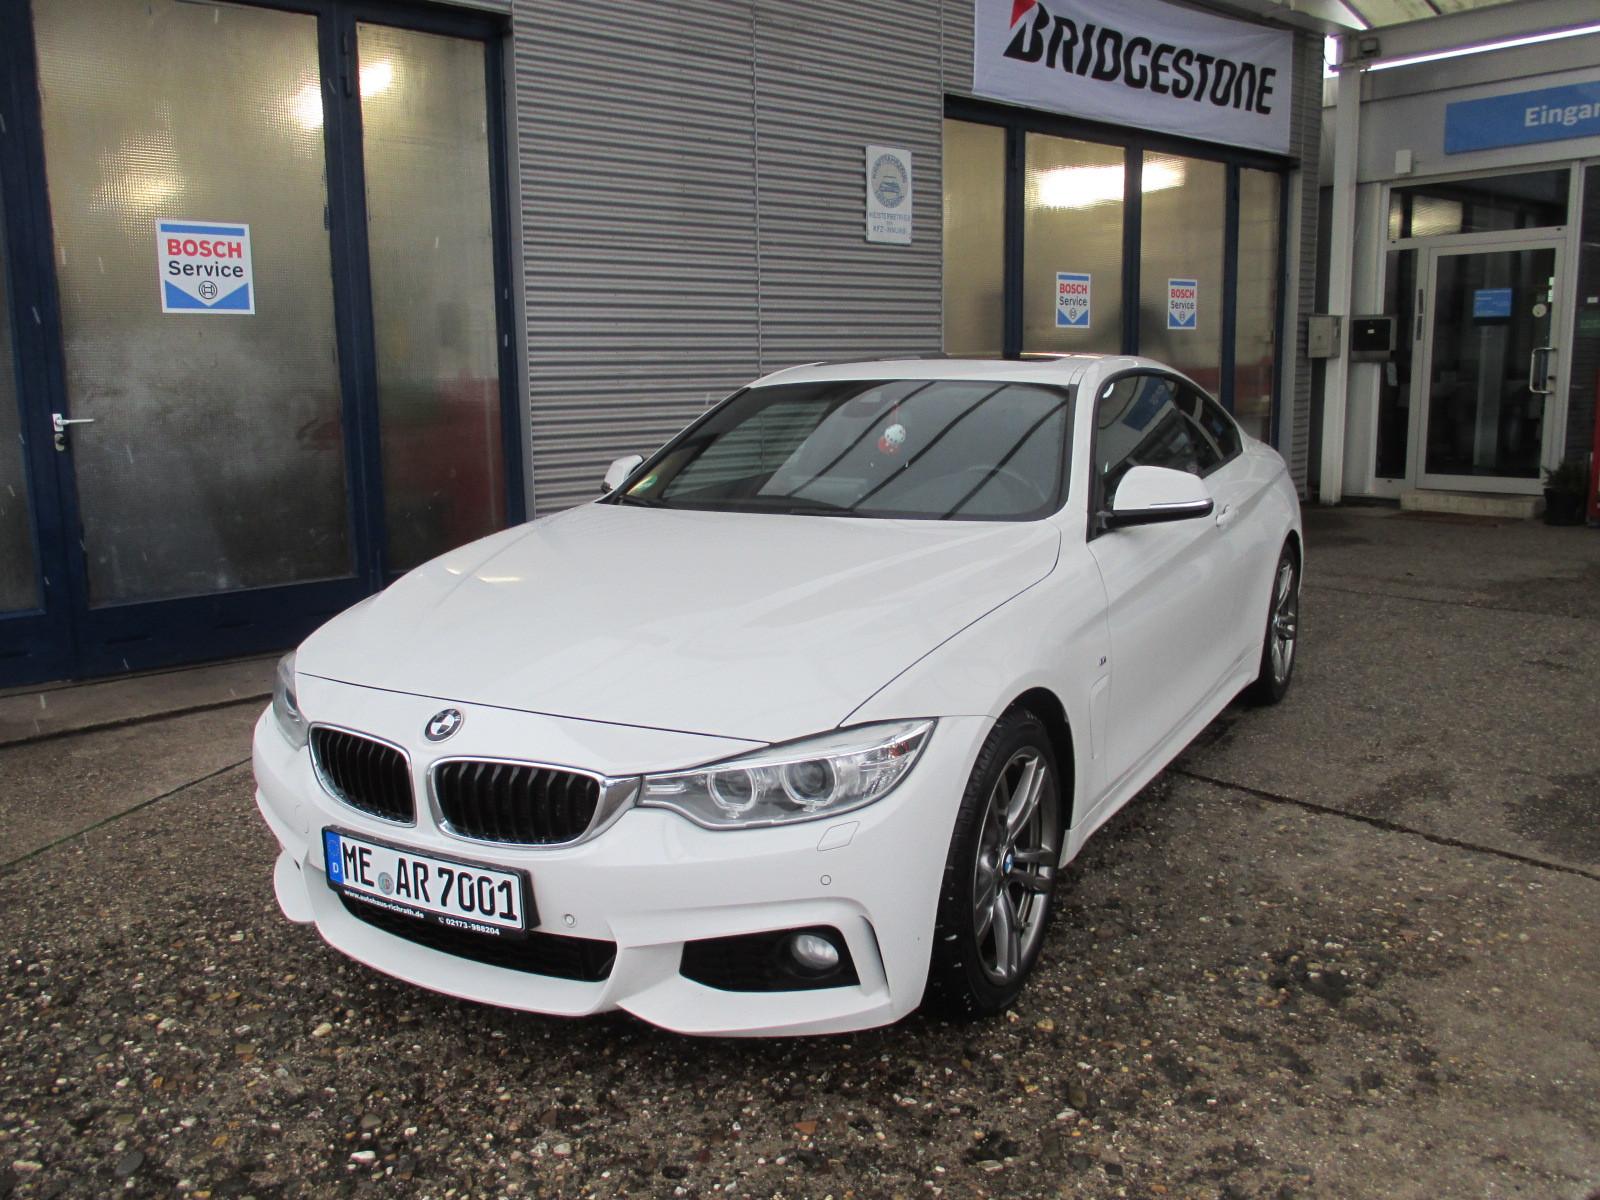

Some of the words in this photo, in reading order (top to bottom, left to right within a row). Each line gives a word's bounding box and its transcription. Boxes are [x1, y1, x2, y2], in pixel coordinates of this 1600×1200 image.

[1003, 0, 1277, 115] BRIDGESTONE
[167, 238, 242, 258] BOSCH
[168, 260, 244, 278] Service
[1059, 283, 1088, 294] BOSCH
[1170, 288, 1195, 299] BOSCH
[1059, 296, 1088, 307] Service
[1170, 300, 1195, 310] Service
[332, 862, 339, 873] D
[342, 841, 375, 888] ME
[396, 857, 431, 903] AR
[437, 866, 518, 922] 7001
[344, 889, 425, 919] www.autohaus-richrath.de
[445, 918, 500, 936] 02173-988204
